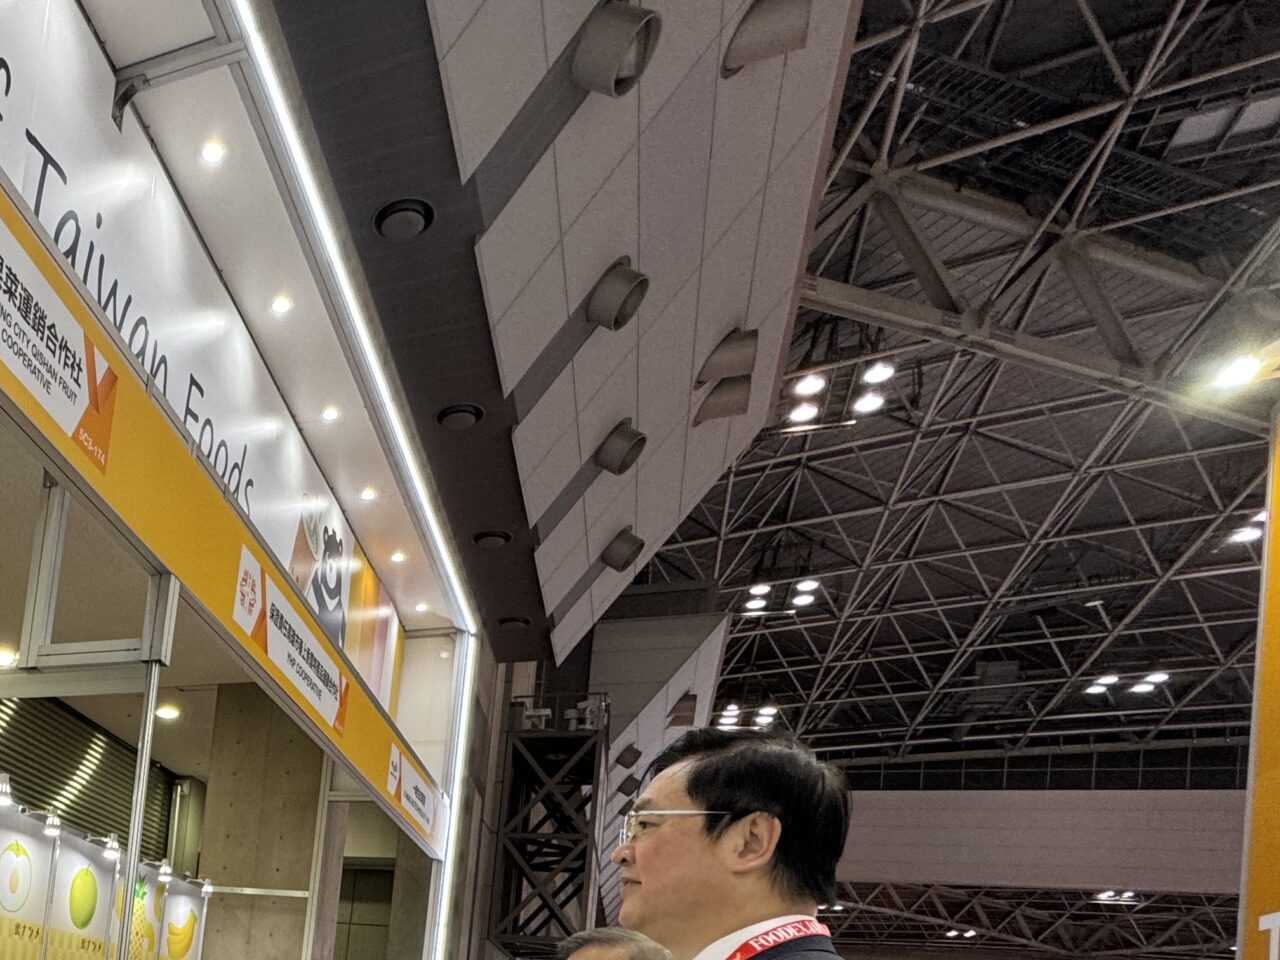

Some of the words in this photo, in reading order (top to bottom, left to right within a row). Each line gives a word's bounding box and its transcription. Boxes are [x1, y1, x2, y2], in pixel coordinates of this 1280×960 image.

[26, 128, 169, 402] Taiwan
[182, 373, 255, 519] Foods
[1, 328, 52, 396] COOPERATIVE
[13, 322, 32, 350] CITY
[31, 344, 59, 383] QISHAN
[58, 377, 79, 406] FRUIT
[748, 920, 808, 951] FOODEX
